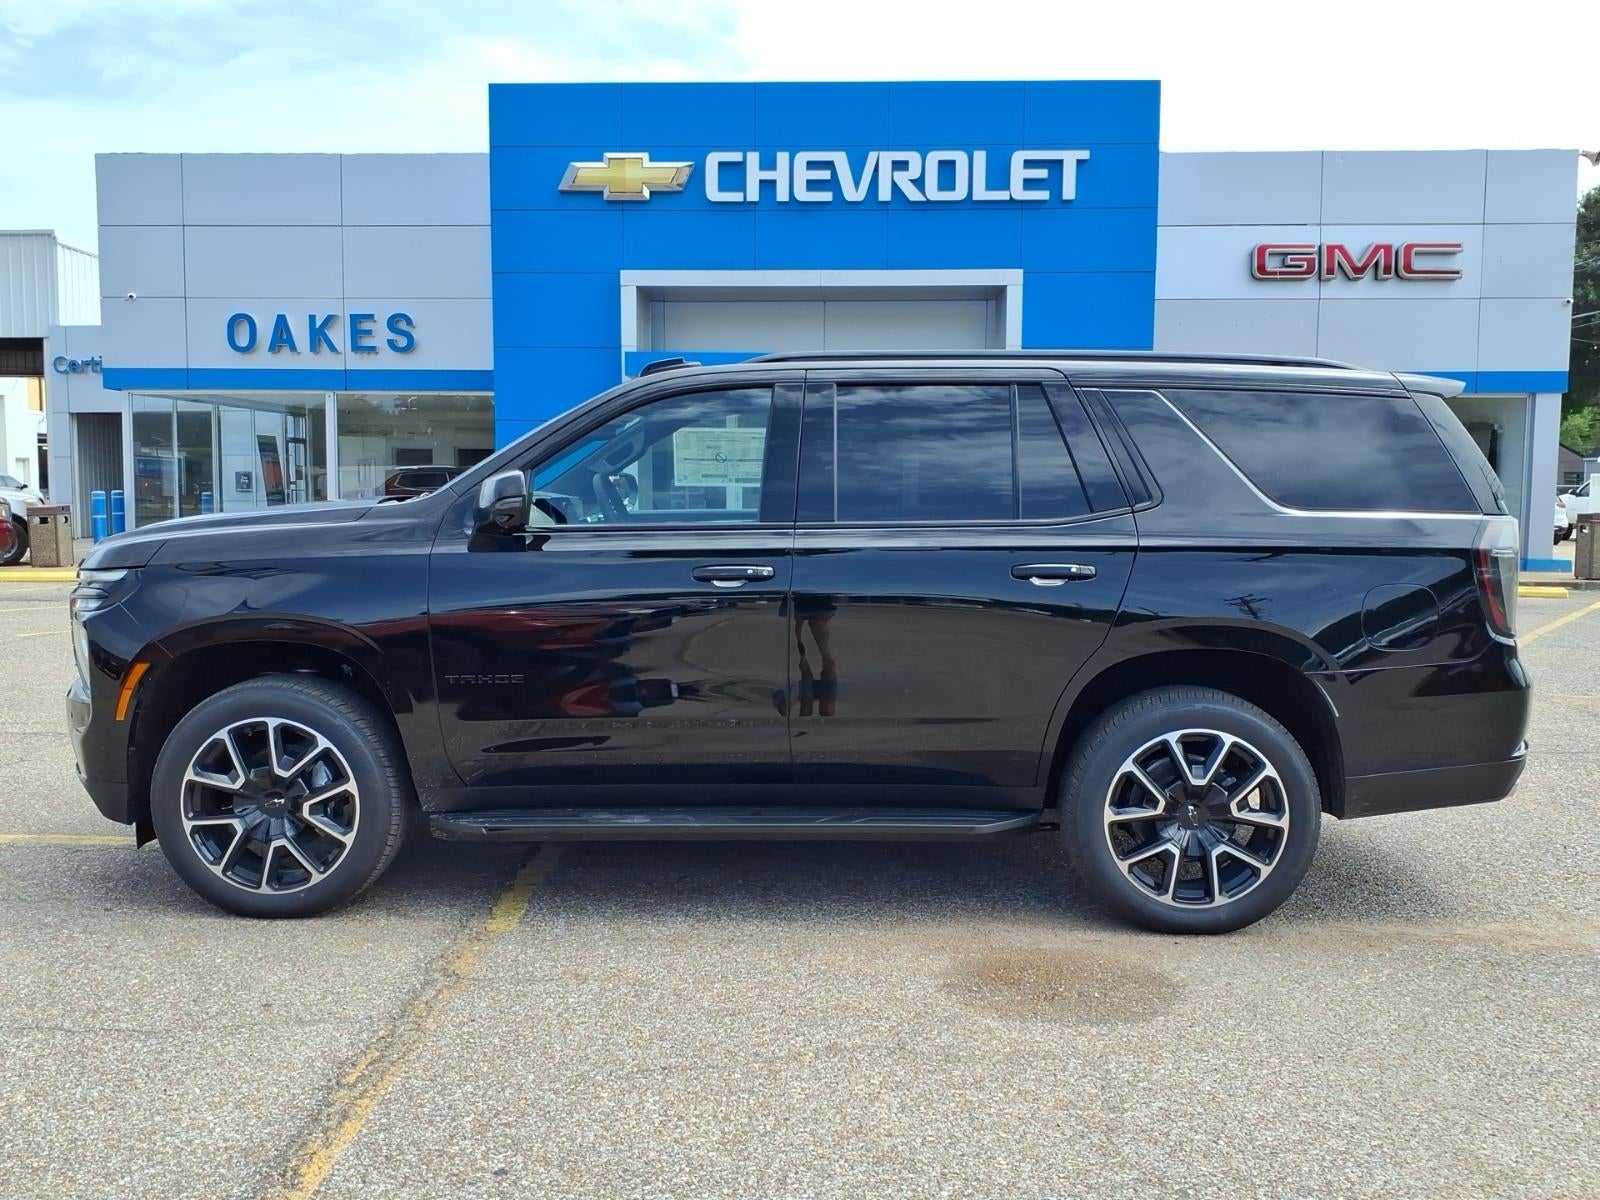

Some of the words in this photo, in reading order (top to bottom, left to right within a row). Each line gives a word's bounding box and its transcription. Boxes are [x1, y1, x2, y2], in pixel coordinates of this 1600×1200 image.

[705, 149, 1091, 203] CHEVROLET
[1251, 241, 1464, 281] GMC
[226, 312, 417, 355] OAKES
[444, 674, 525, 684] TAHOE
